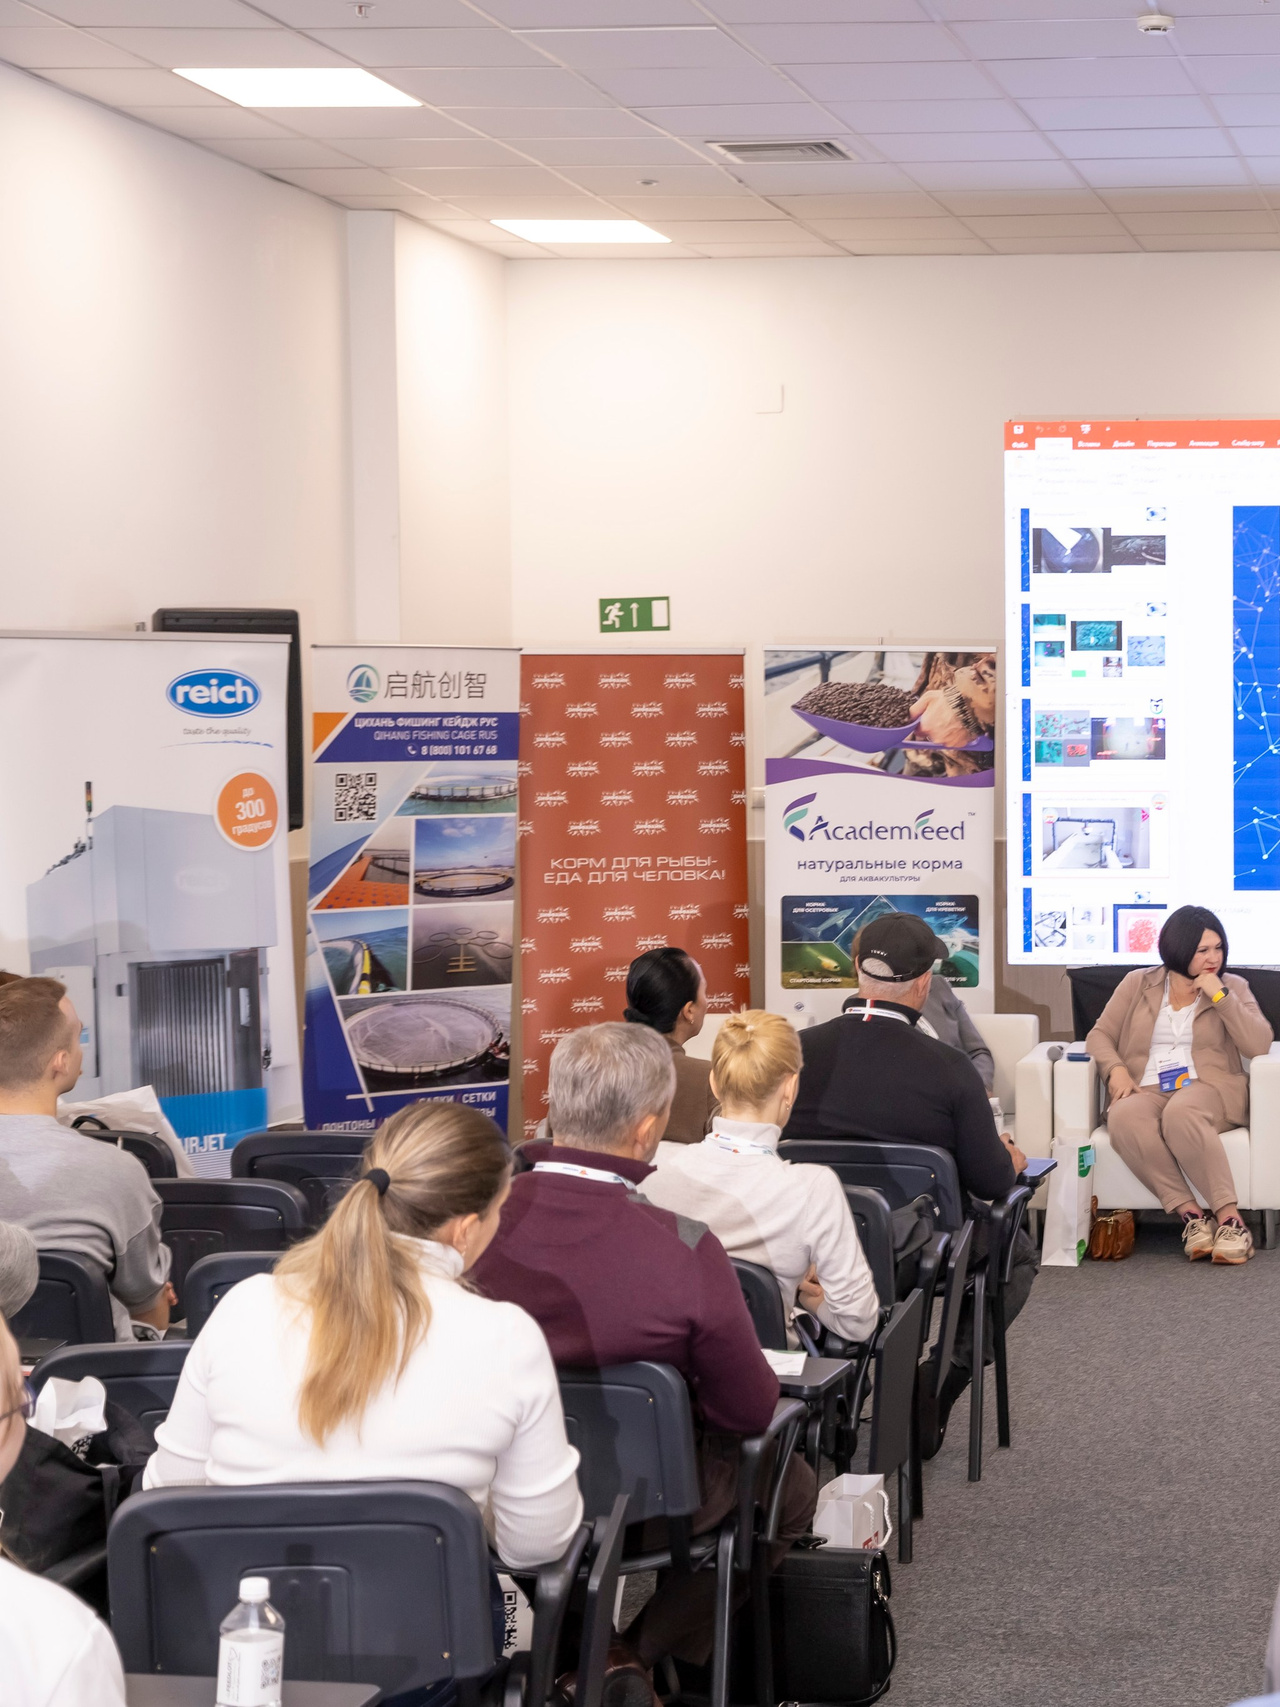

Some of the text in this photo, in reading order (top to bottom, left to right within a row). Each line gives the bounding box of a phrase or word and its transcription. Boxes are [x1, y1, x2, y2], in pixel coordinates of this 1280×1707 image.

[176, 678, 254, 704] reich
[383, 670, 488, 700] 启航创智
[354, 715, 498, 729] ЦИХАНЬ ФИШИНГ КЕЙДЖ РУС
[373, 730, 498, 741] QIHANG FISHING CAGE RUS
[421, 745, 498, 757] 8 (800) 101 67 68
[242, 786, 255, 799] до
[235, 798, 267, 821] 300
[231, 820, 273, 837] градусов
[550, 856, 718, 870] КОРМ ДЛЯ РЫБЫ-
[797, 860, 963, 873] натуральные корма
[544, 869, 726, 885] ЕДА ДЛЯ ЧЕЛОВКА!
[840, 875, 921, 884] ДЛЯ АКВАКУЛЬТУРЫ
[461, 1091, 497, 1104] СЕТКИ
